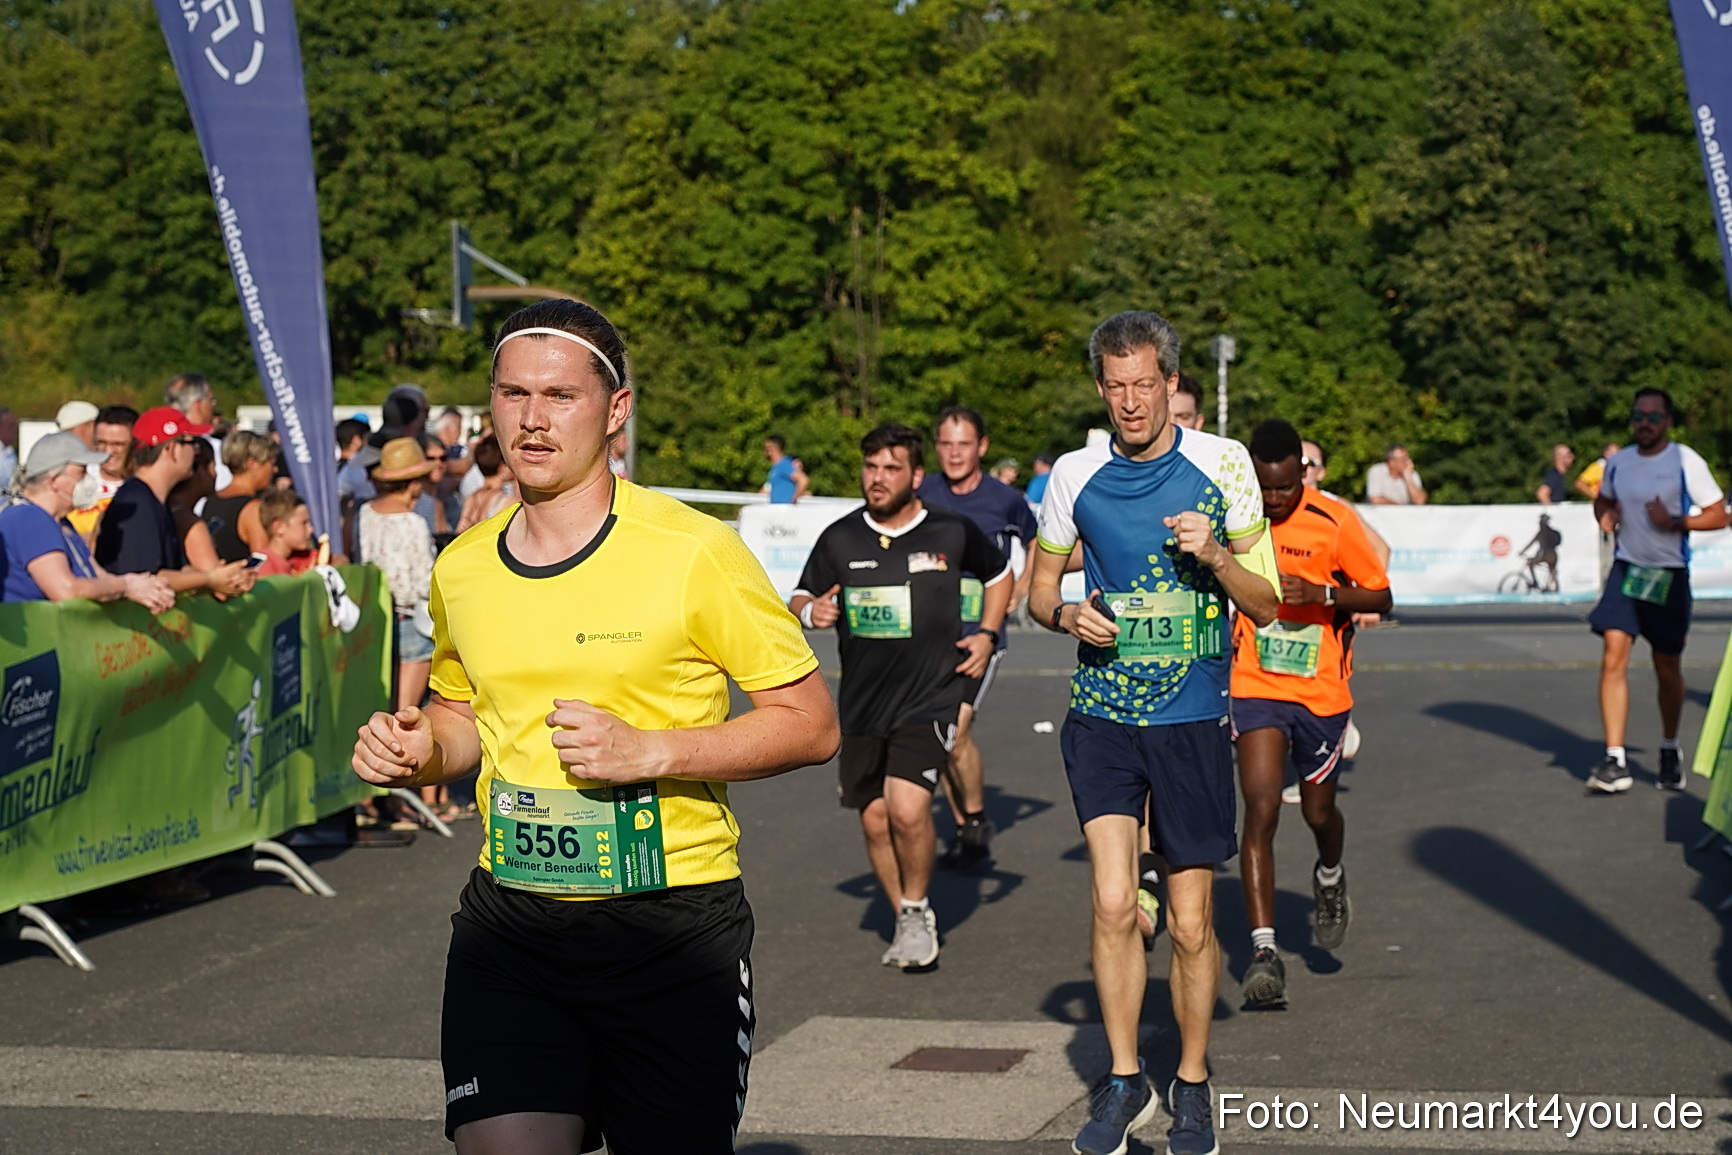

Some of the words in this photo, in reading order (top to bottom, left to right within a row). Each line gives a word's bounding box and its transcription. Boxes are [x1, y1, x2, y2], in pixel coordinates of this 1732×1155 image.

[860, 605, 893, 621] 426
[587, 631, 642, 641] SPANGLER
[1125, 616, 1173, 639] 713
[1182, 618, 1193, 651] 2022
[1261, 637, 1309, 658] 1377
[513, 804, 551, 815] Firmenlauf
[494, 828, 505, 865] RUN
[515, 821, 580, 859] 556
[504, 855, 542, 872] Werner
[544, 861, 600, 874] Benedikt
[596, 830, 613, 879] 2022
